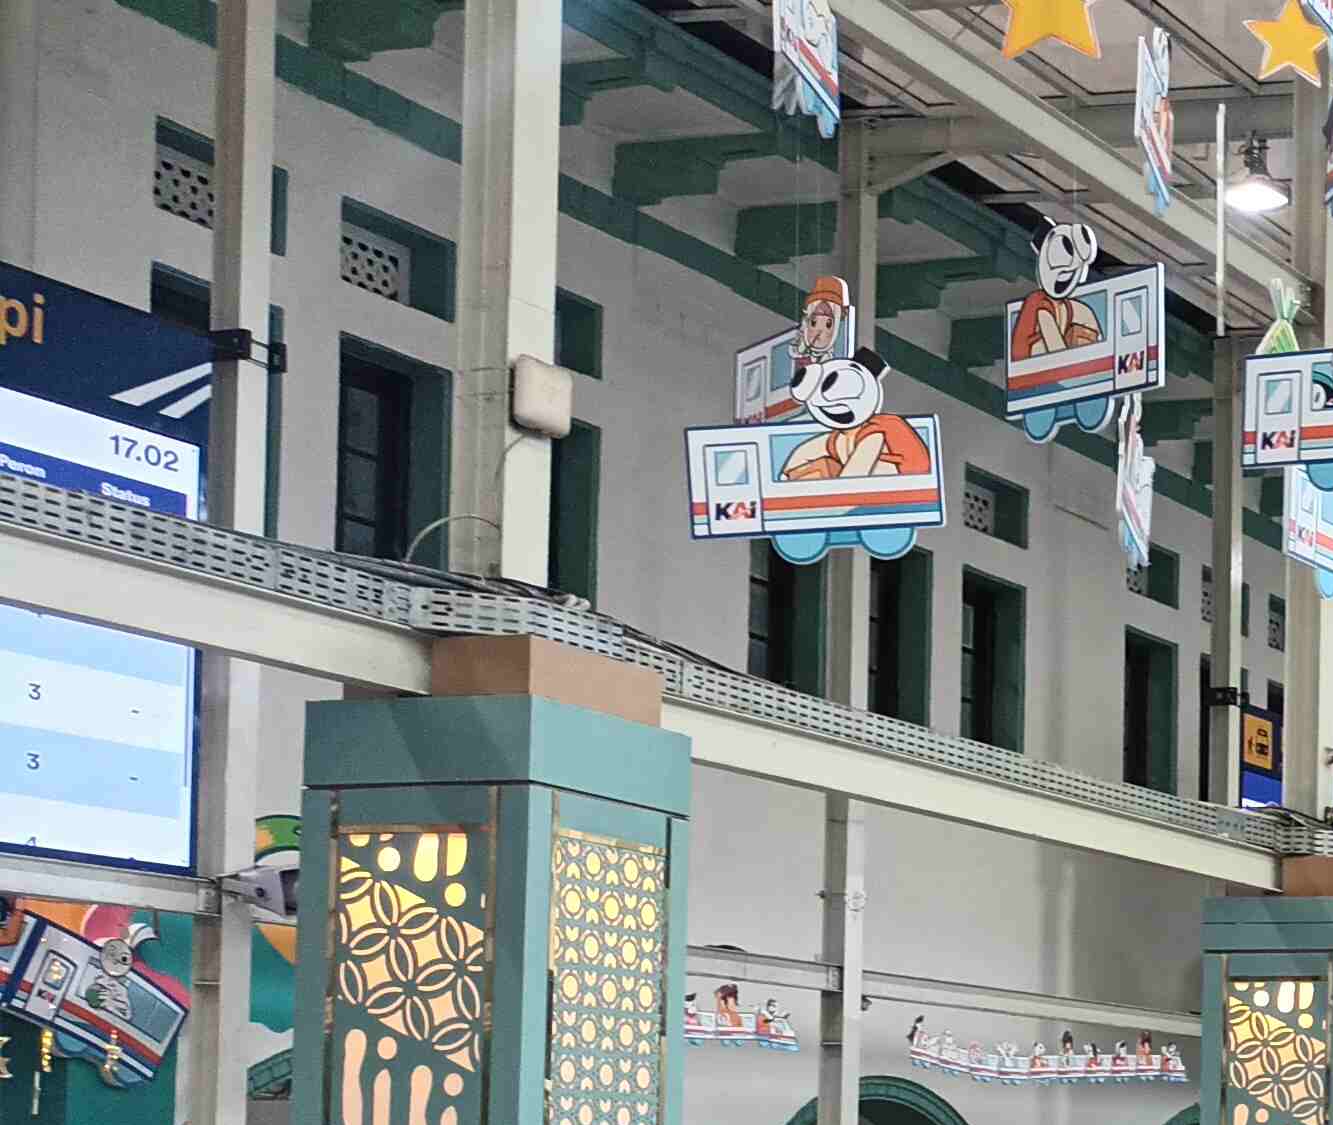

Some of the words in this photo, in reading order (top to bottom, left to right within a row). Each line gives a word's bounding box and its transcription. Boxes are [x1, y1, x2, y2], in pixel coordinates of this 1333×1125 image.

[109, 434, 180, 473] 17.02
[100, 481, 152, 507] Status
[28, 682, 42, 701] 3
[26, 752, 41, 771] 3
